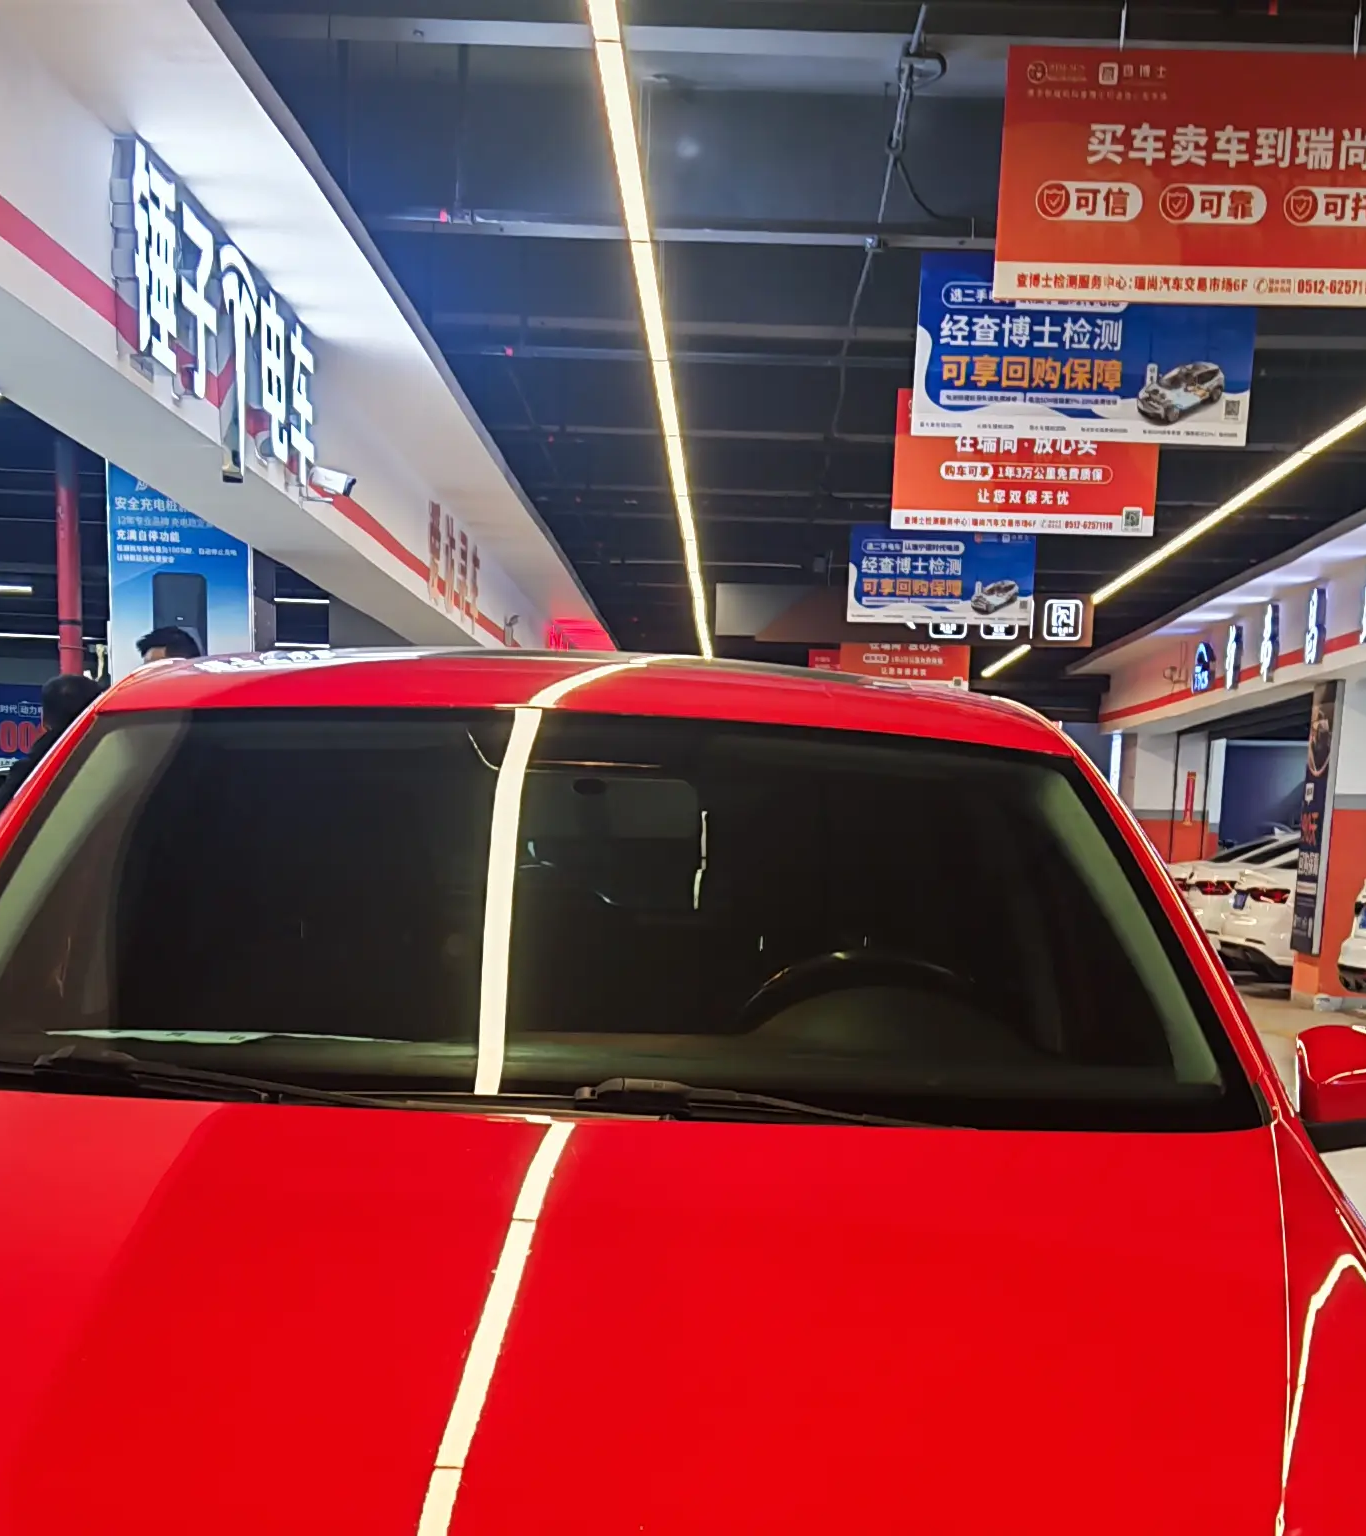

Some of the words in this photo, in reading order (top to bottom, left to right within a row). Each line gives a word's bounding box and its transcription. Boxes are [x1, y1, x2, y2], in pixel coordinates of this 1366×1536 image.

[1074, 187, 1131, 218] 可信
[1199, 189, 1254, 220] 可靠
[132, 137, 217, 400] 锤子
[259, 296, 317, 482] 电车
[940, 314, 1123, 351] 经查博士检测
[940, 355, 1123, 391] 可享回购保障
[861, 556, 962, 575] 经查博士检测
[862, 578, 963, 597] 可享回购保障
